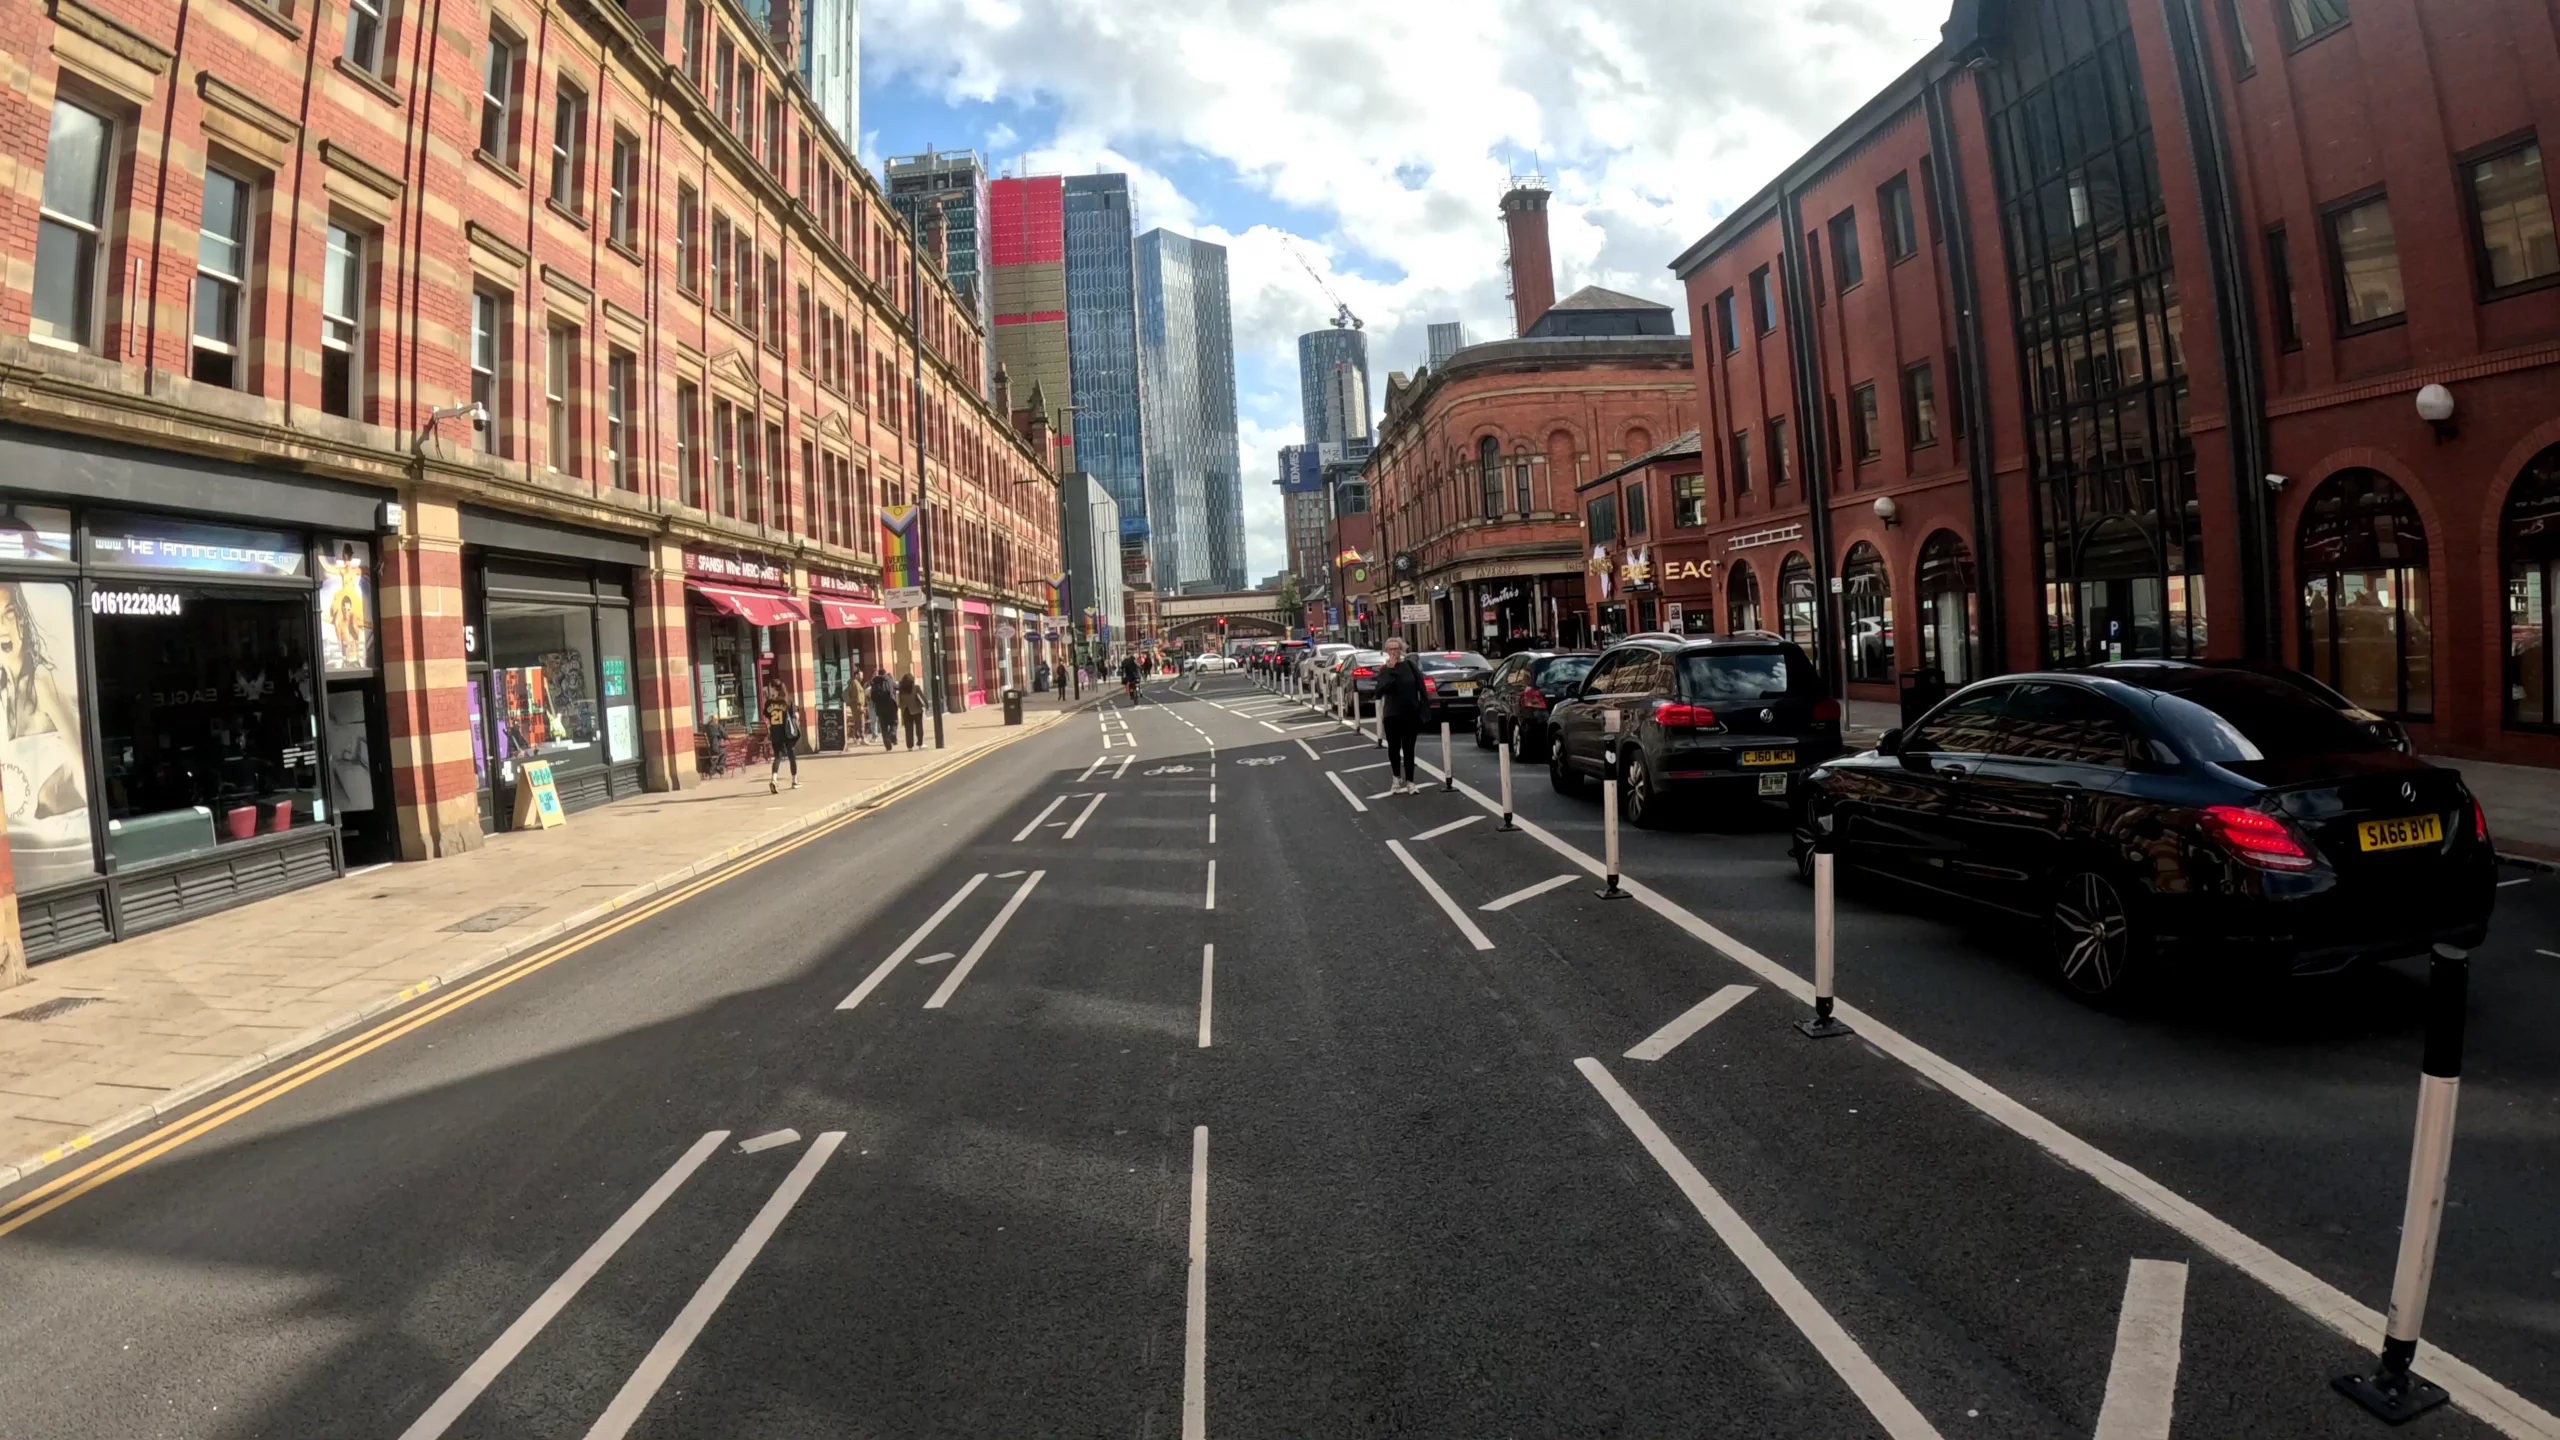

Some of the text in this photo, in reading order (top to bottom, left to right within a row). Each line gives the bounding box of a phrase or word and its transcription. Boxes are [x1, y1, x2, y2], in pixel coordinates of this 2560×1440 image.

[157, 537, 217, 559] TANNING
[220, 549, 276, 563] LOUNGE
[698, 554, 725, 574] SPANISH
[726, 559, 742, 577] WINE
[741, 561, 776, 581] MERCANTS
[91, 591, 182, 616] 01612228434
[771, 710, 783, 725] 21
[2367, 817, 2434, 846] SA66 BYT
